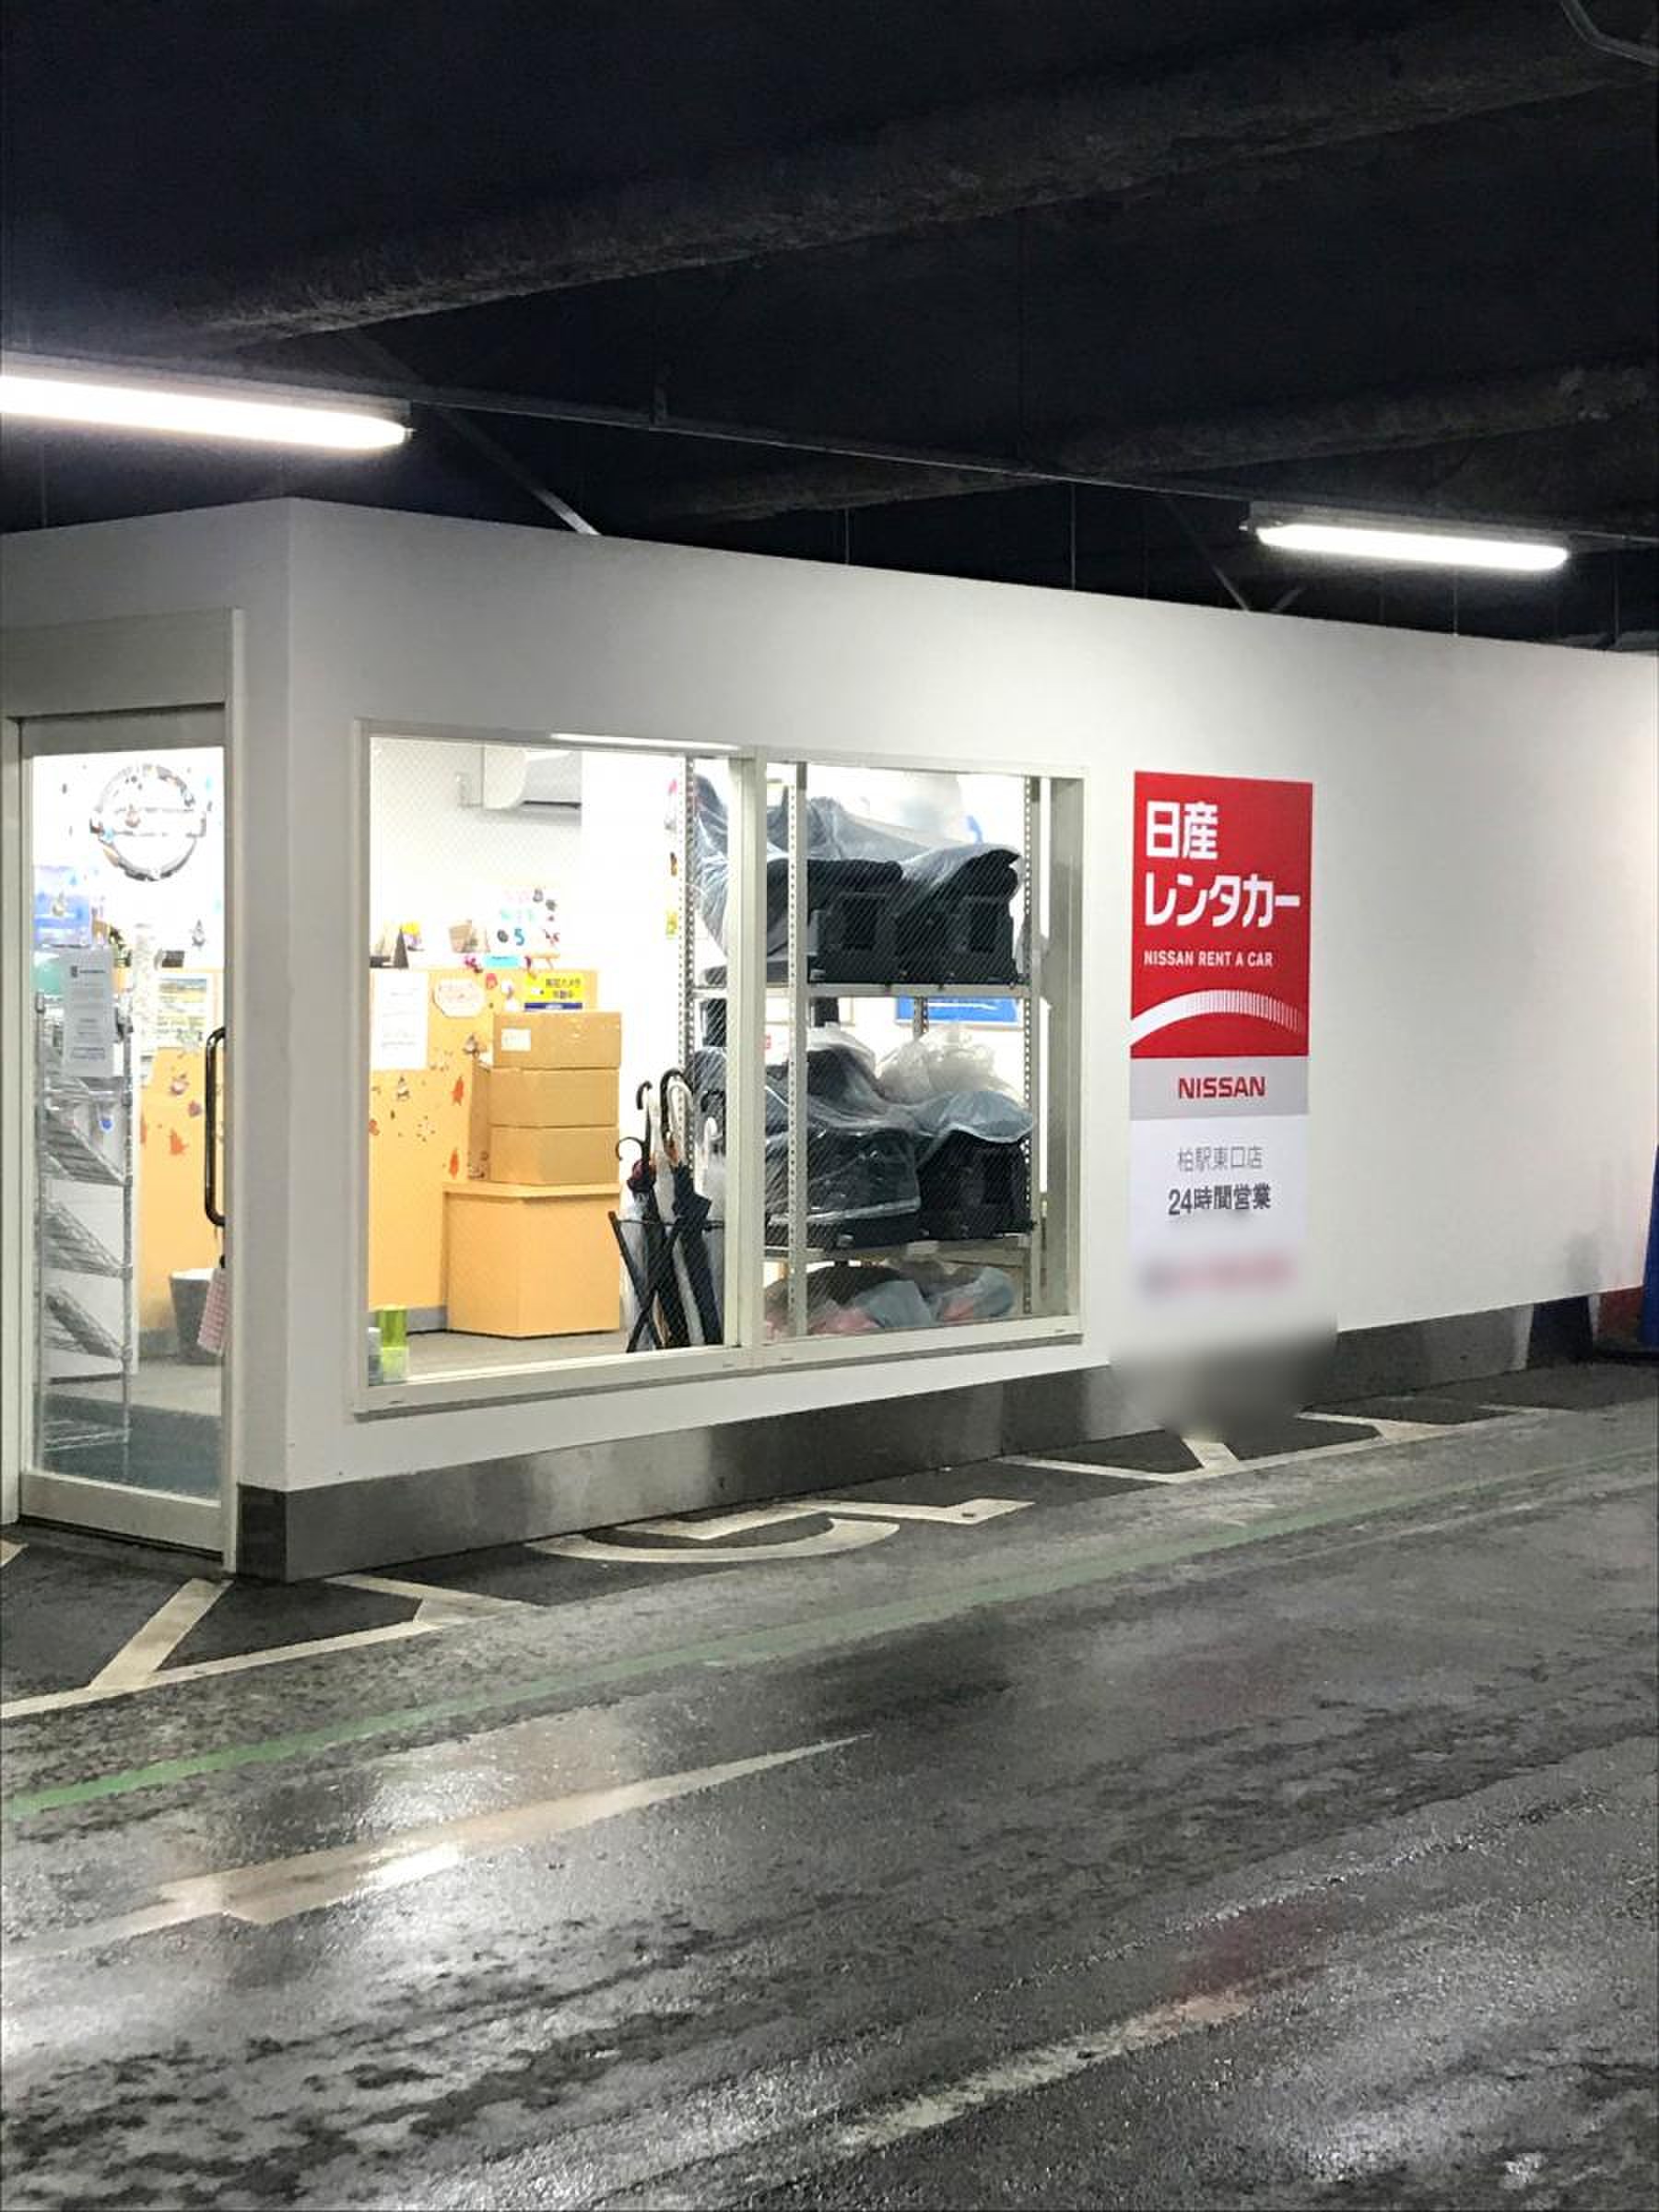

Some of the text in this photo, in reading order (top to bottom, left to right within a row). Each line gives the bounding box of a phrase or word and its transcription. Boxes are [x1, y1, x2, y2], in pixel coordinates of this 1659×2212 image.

[1146, 800, 1218, 860] 日産
[1145, 871, 1301, 928] レンタカー
[1144, 949, 1273, 968] NISSAN RENT A CAR
[1179, 1076, 1265, 1099] NISSAN
[1178, 1146, 1264, 1172] 柏駅東口店
[1168, 1182, 1271, 1216] 24時間営業
